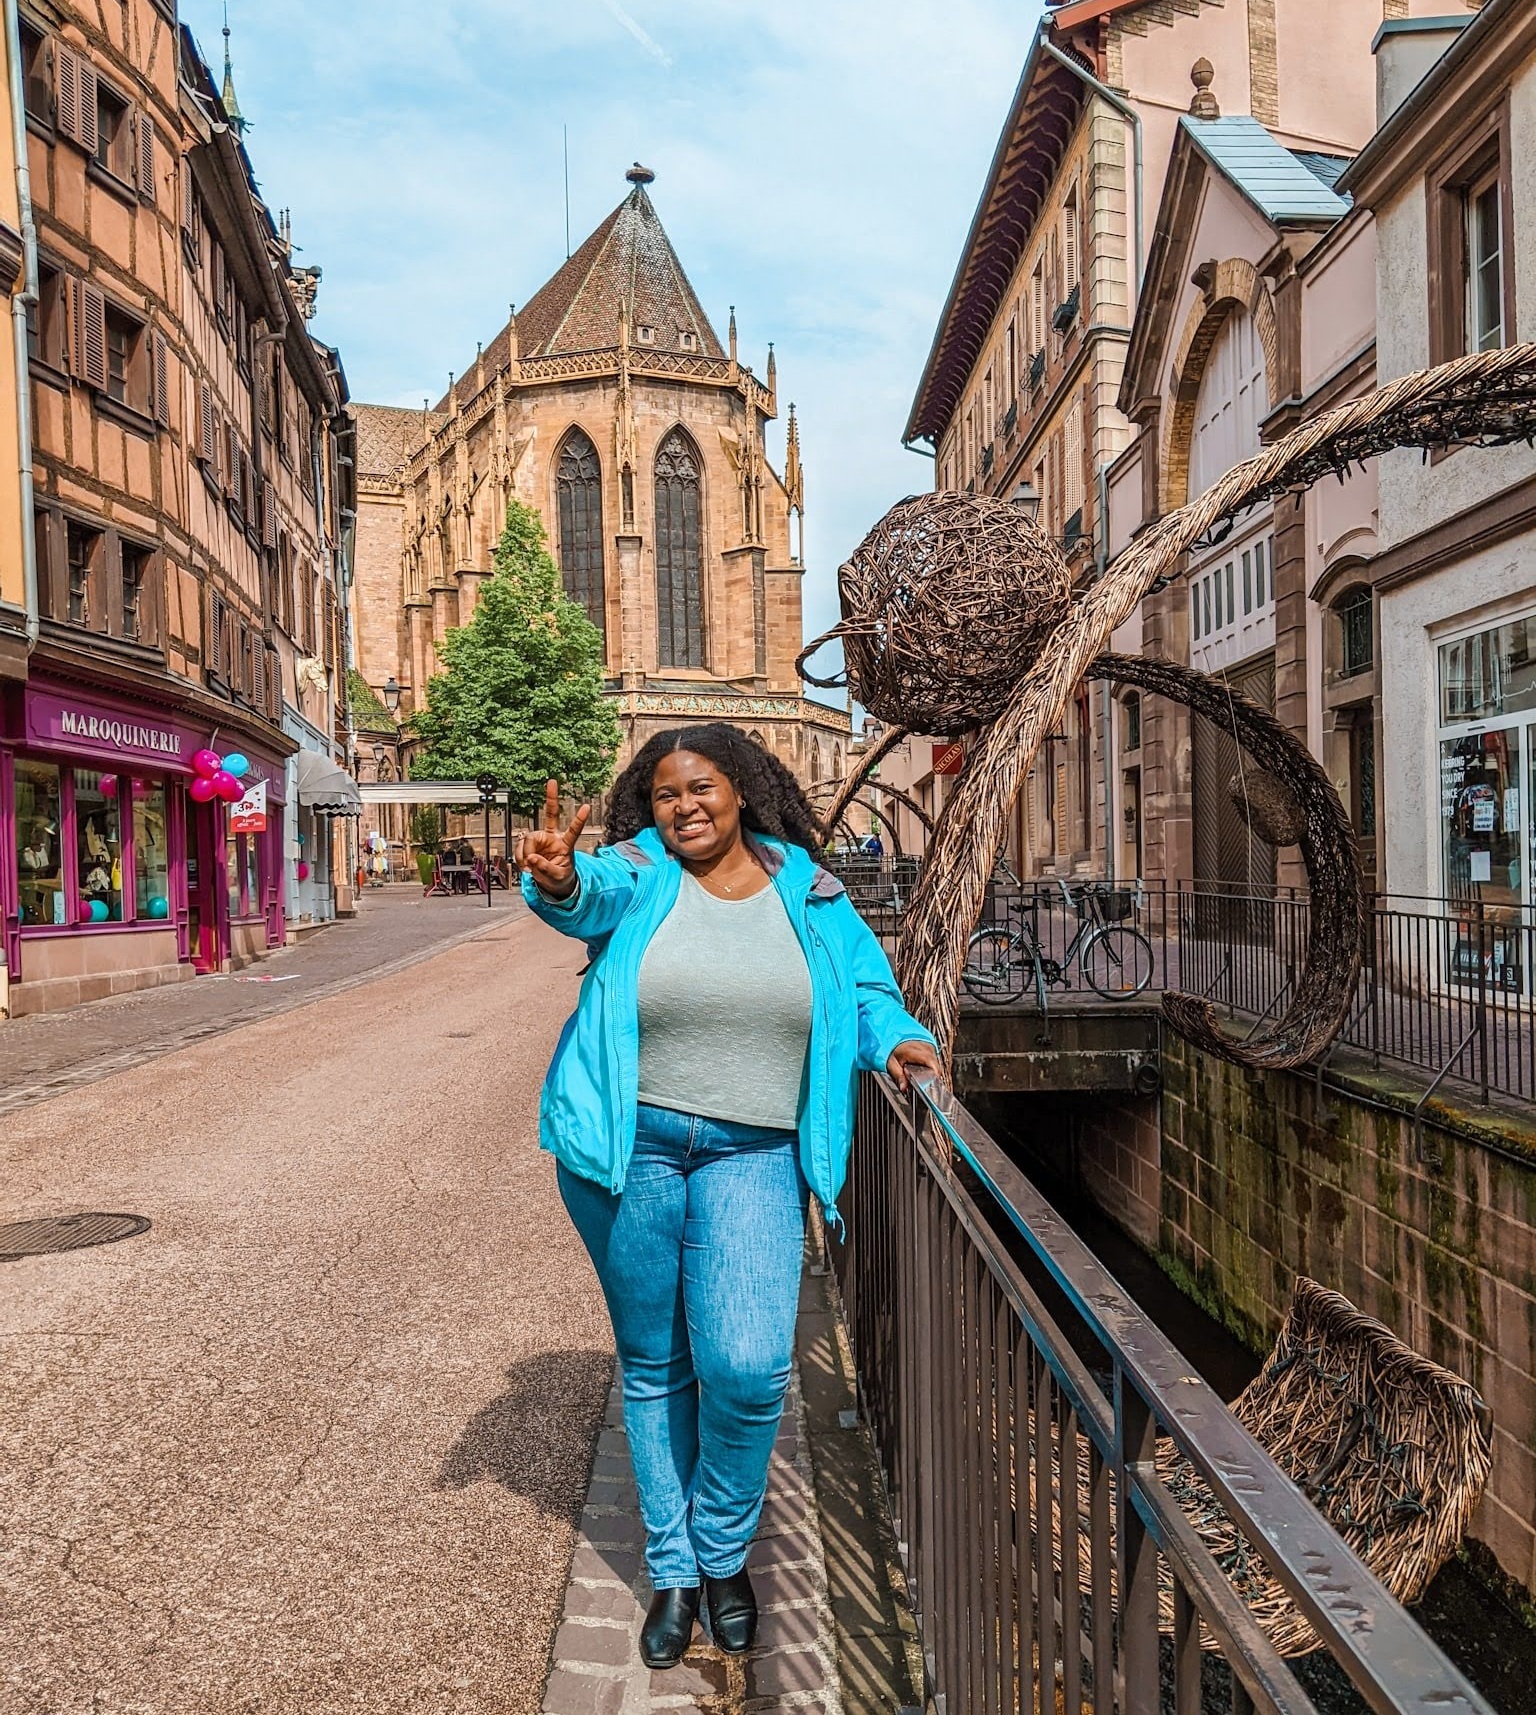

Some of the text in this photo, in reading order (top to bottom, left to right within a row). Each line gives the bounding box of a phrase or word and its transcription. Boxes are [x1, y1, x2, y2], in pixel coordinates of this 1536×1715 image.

[61, 710, 181, 755] MAROQUINERIE
[934, 746, 961, 773] NICOLAS
[1441, 771, 1465, 784] YOU DRY
[1441, 788, 1458, 800] SINCE
